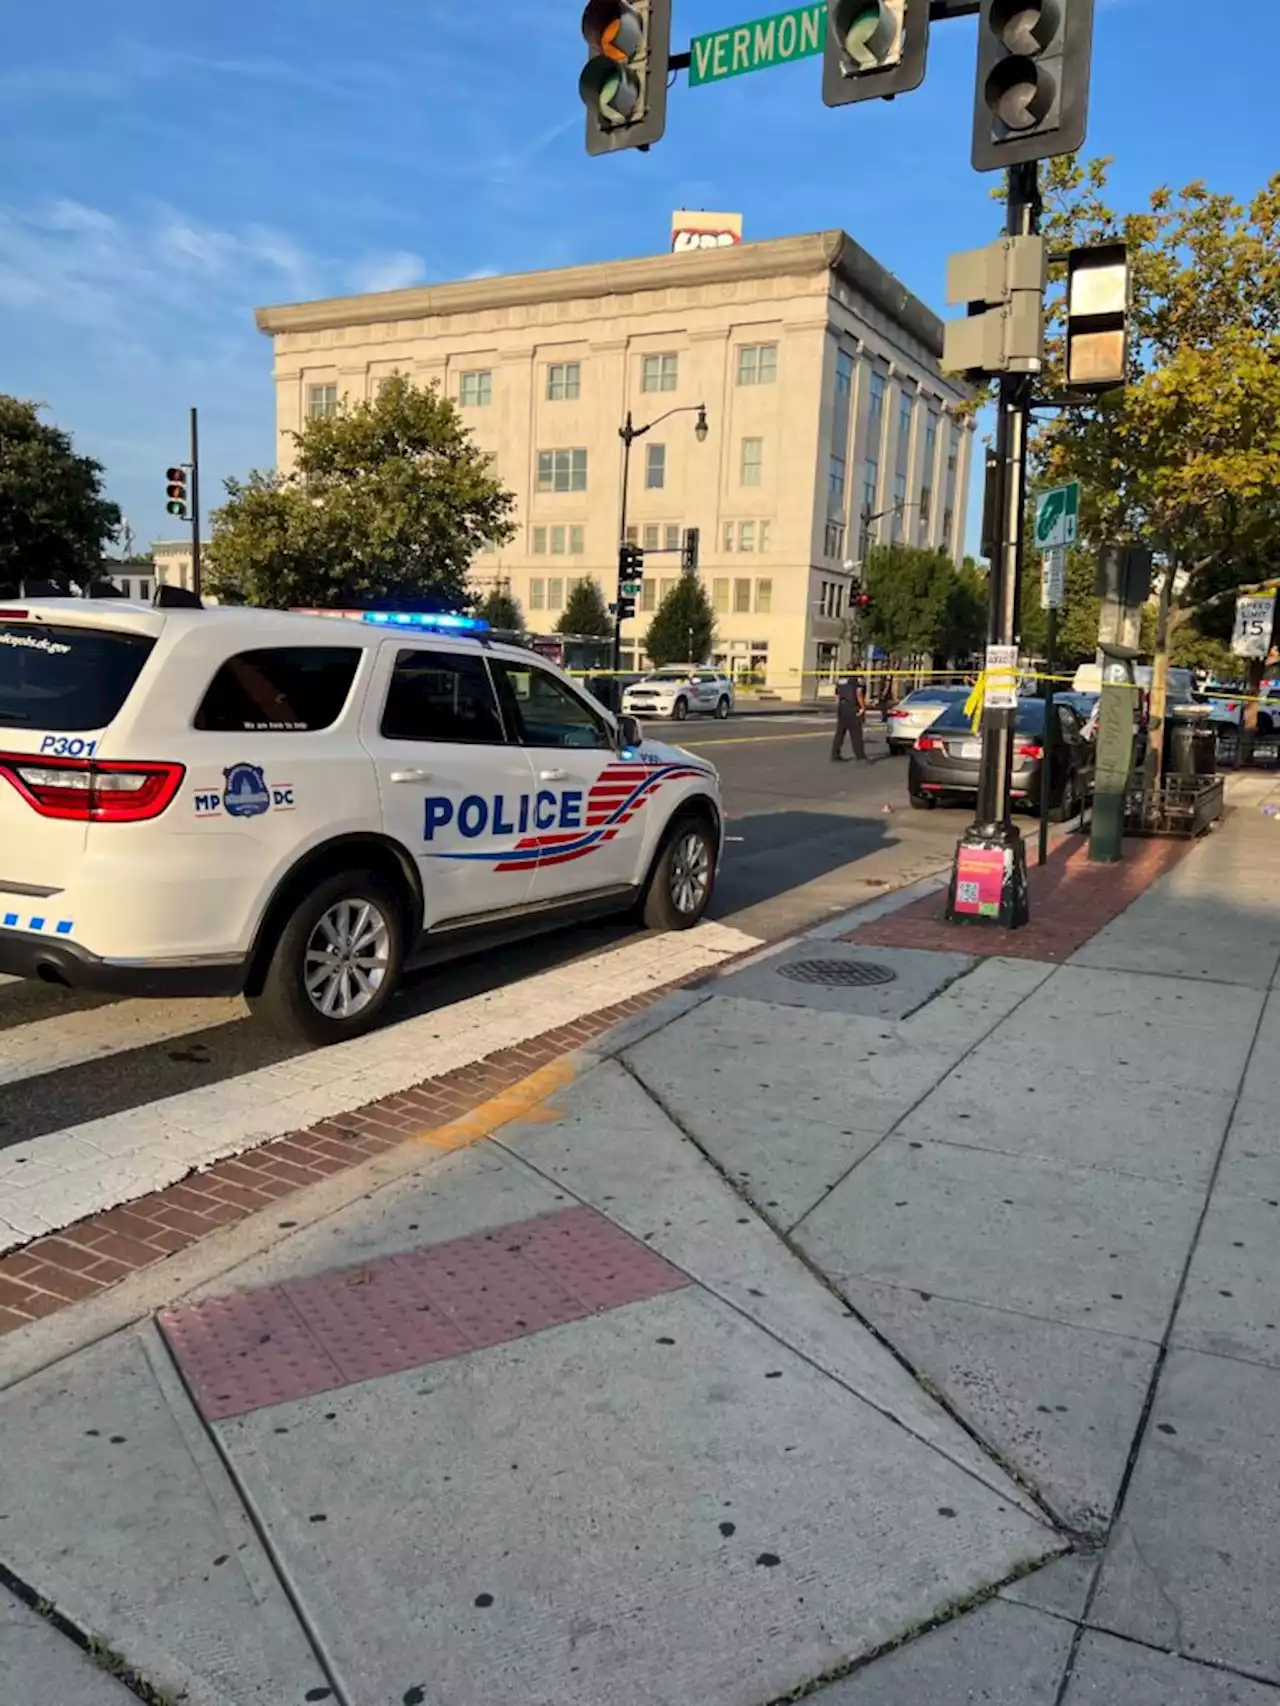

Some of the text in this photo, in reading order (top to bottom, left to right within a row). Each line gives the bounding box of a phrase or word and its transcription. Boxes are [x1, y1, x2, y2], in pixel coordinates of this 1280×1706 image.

[694, 6, 829, 80] VERMON
[1242, 620, 1264, 636] 15
[194, 795, 220, 811] MP
[273, 789, 294, 805] DC
[423, 790, 583, 840] POLICE
